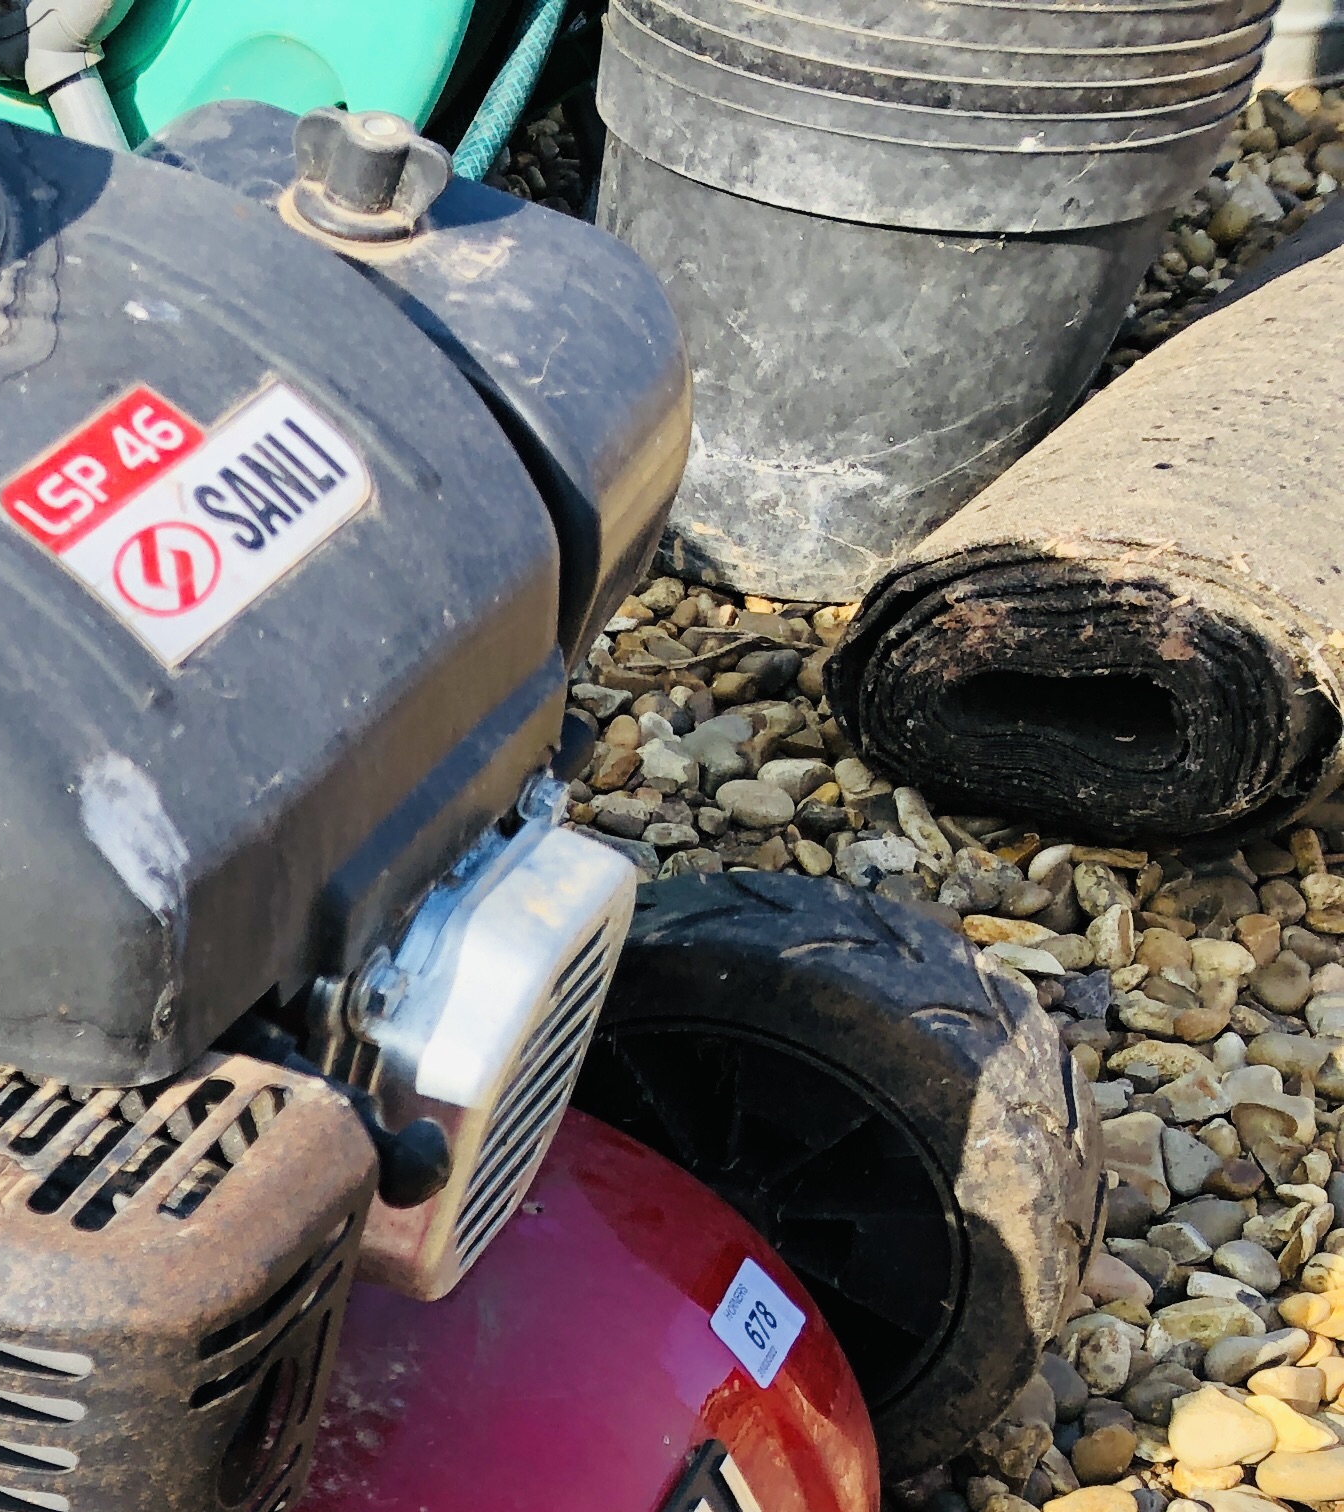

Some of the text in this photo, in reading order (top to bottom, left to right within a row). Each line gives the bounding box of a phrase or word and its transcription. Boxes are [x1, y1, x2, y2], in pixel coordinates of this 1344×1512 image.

[14, 405, 184, 536] LSP 46
[193, 417, 348, 551] SANLI
[744, 1300, 777, 1350] 678
